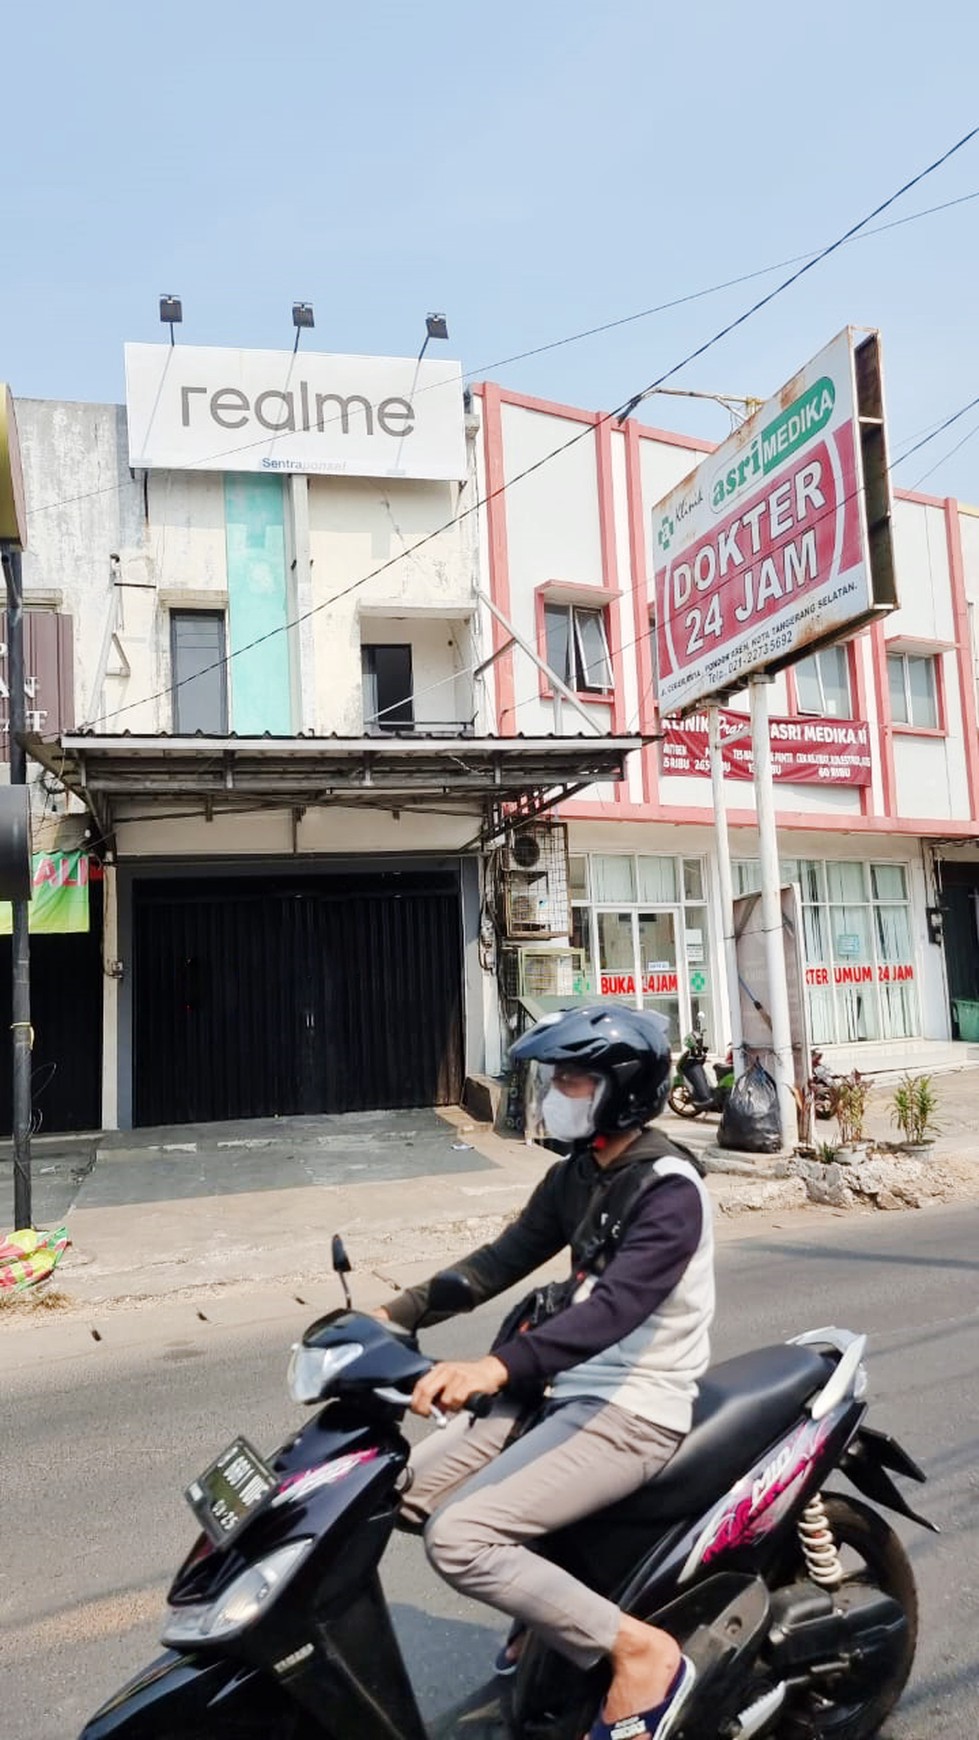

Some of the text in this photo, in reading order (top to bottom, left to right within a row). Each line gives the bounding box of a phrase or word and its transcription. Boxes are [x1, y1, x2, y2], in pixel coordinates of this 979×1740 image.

[181, 381, 415, 437] realme
[713, 440, 762, 507] asri
[762, 389, 833, 464] MEDIKA
[672, 460, 826, 611] DOKTER
[684, 527, 819, 656] 24 JAM
[770, 723, 801, 741] ASRI
[804, 726, 857, 744] MEDIKA
[600, 974, 635, 995] BUKA
[655, 973, 679, 992] JAM
[805, 965, 914, 985] KTER UMUM 24 JAM
